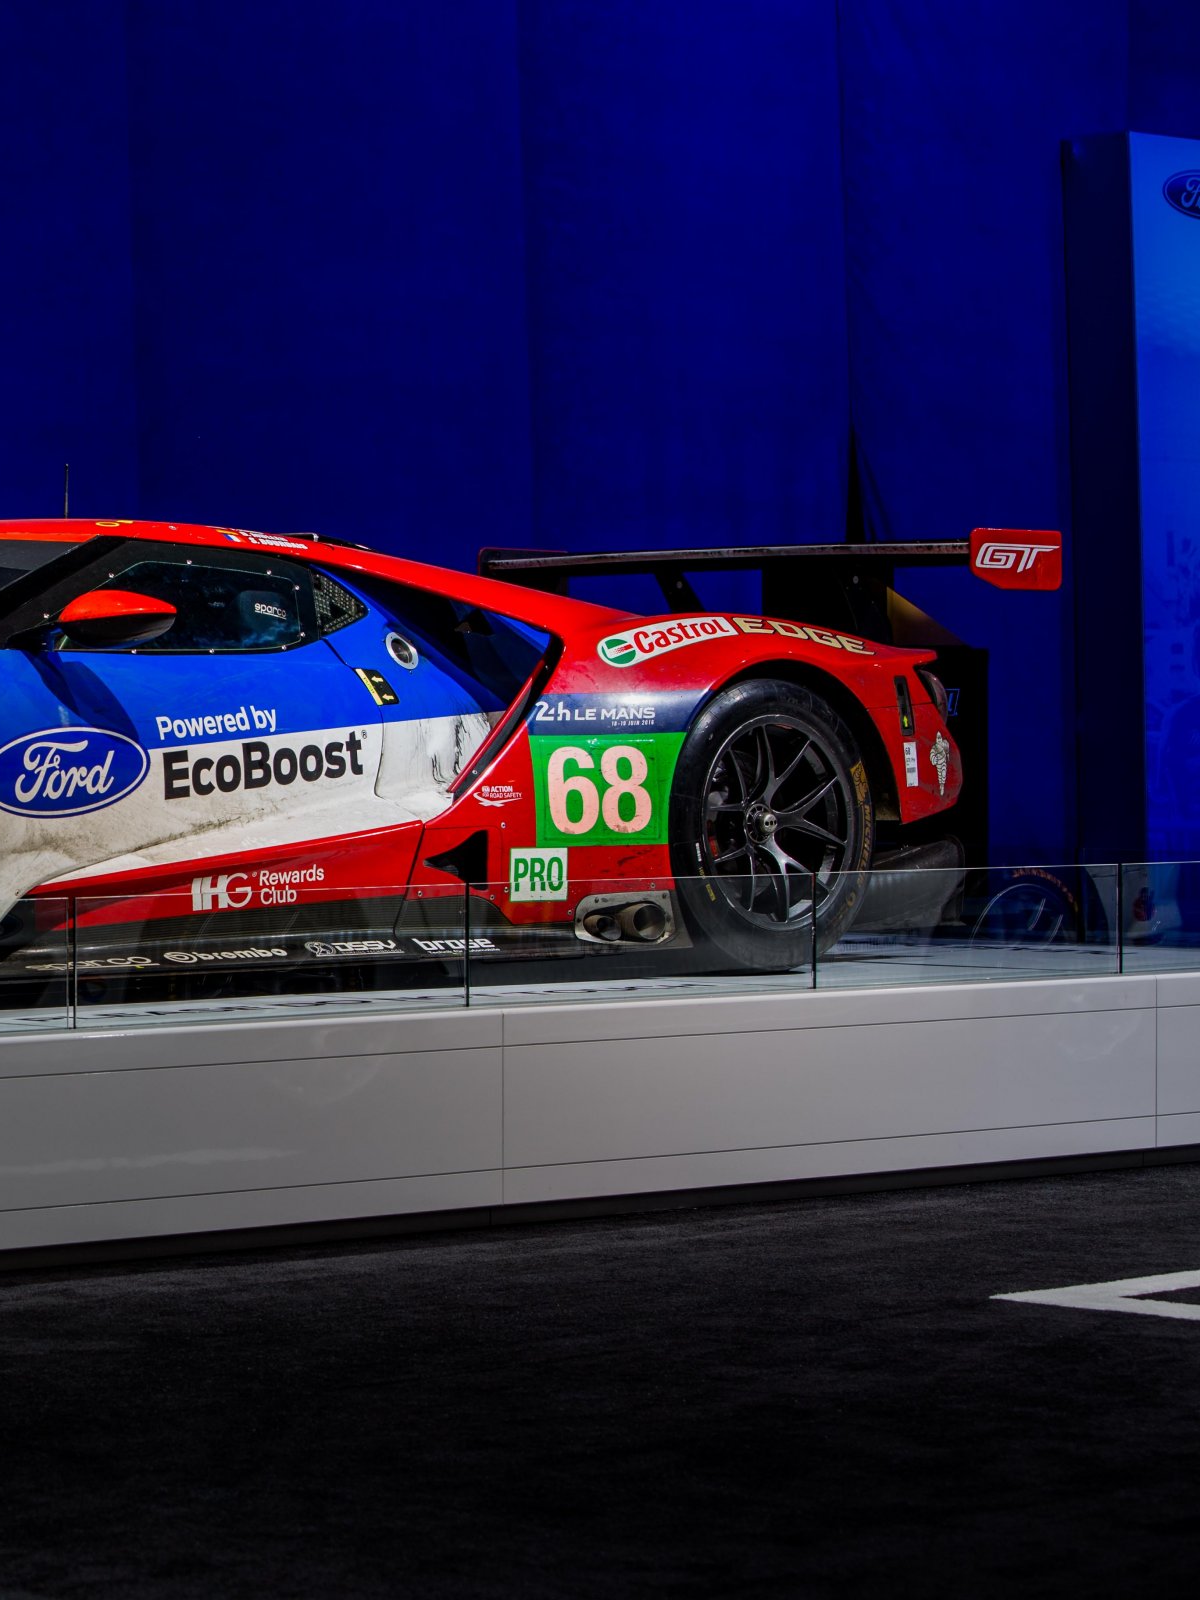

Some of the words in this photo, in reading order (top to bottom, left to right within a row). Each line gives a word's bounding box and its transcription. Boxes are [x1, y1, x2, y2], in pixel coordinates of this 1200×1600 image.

[975, 542, 1061, 573] GT
[254, 602, 287, 620] sparco
[633, 619, 730, 654] Castrol
[732, 616, 876, 656] EDGE
[156, 708, 247, 741] Powered
[250, 705, 277, 733] by
[574, 708, 597, 721] LE
[600, 706, 656, 721] MANS
[13, 739, 115, 804] Ford
[163, 731, 363, 800] EcoBoost
[547, 745, 653, 835] 68
[259, 864, 325, 887] Rewards
[514, 857, 564, 892] PRO
[191, 872, 253, 911] IHG
[260, 887, 298, 905] Club
[195, 948, 288, 961] brembo
[330, 940, 399, 951] DSSV
[411, 937, 496, 951] brose
